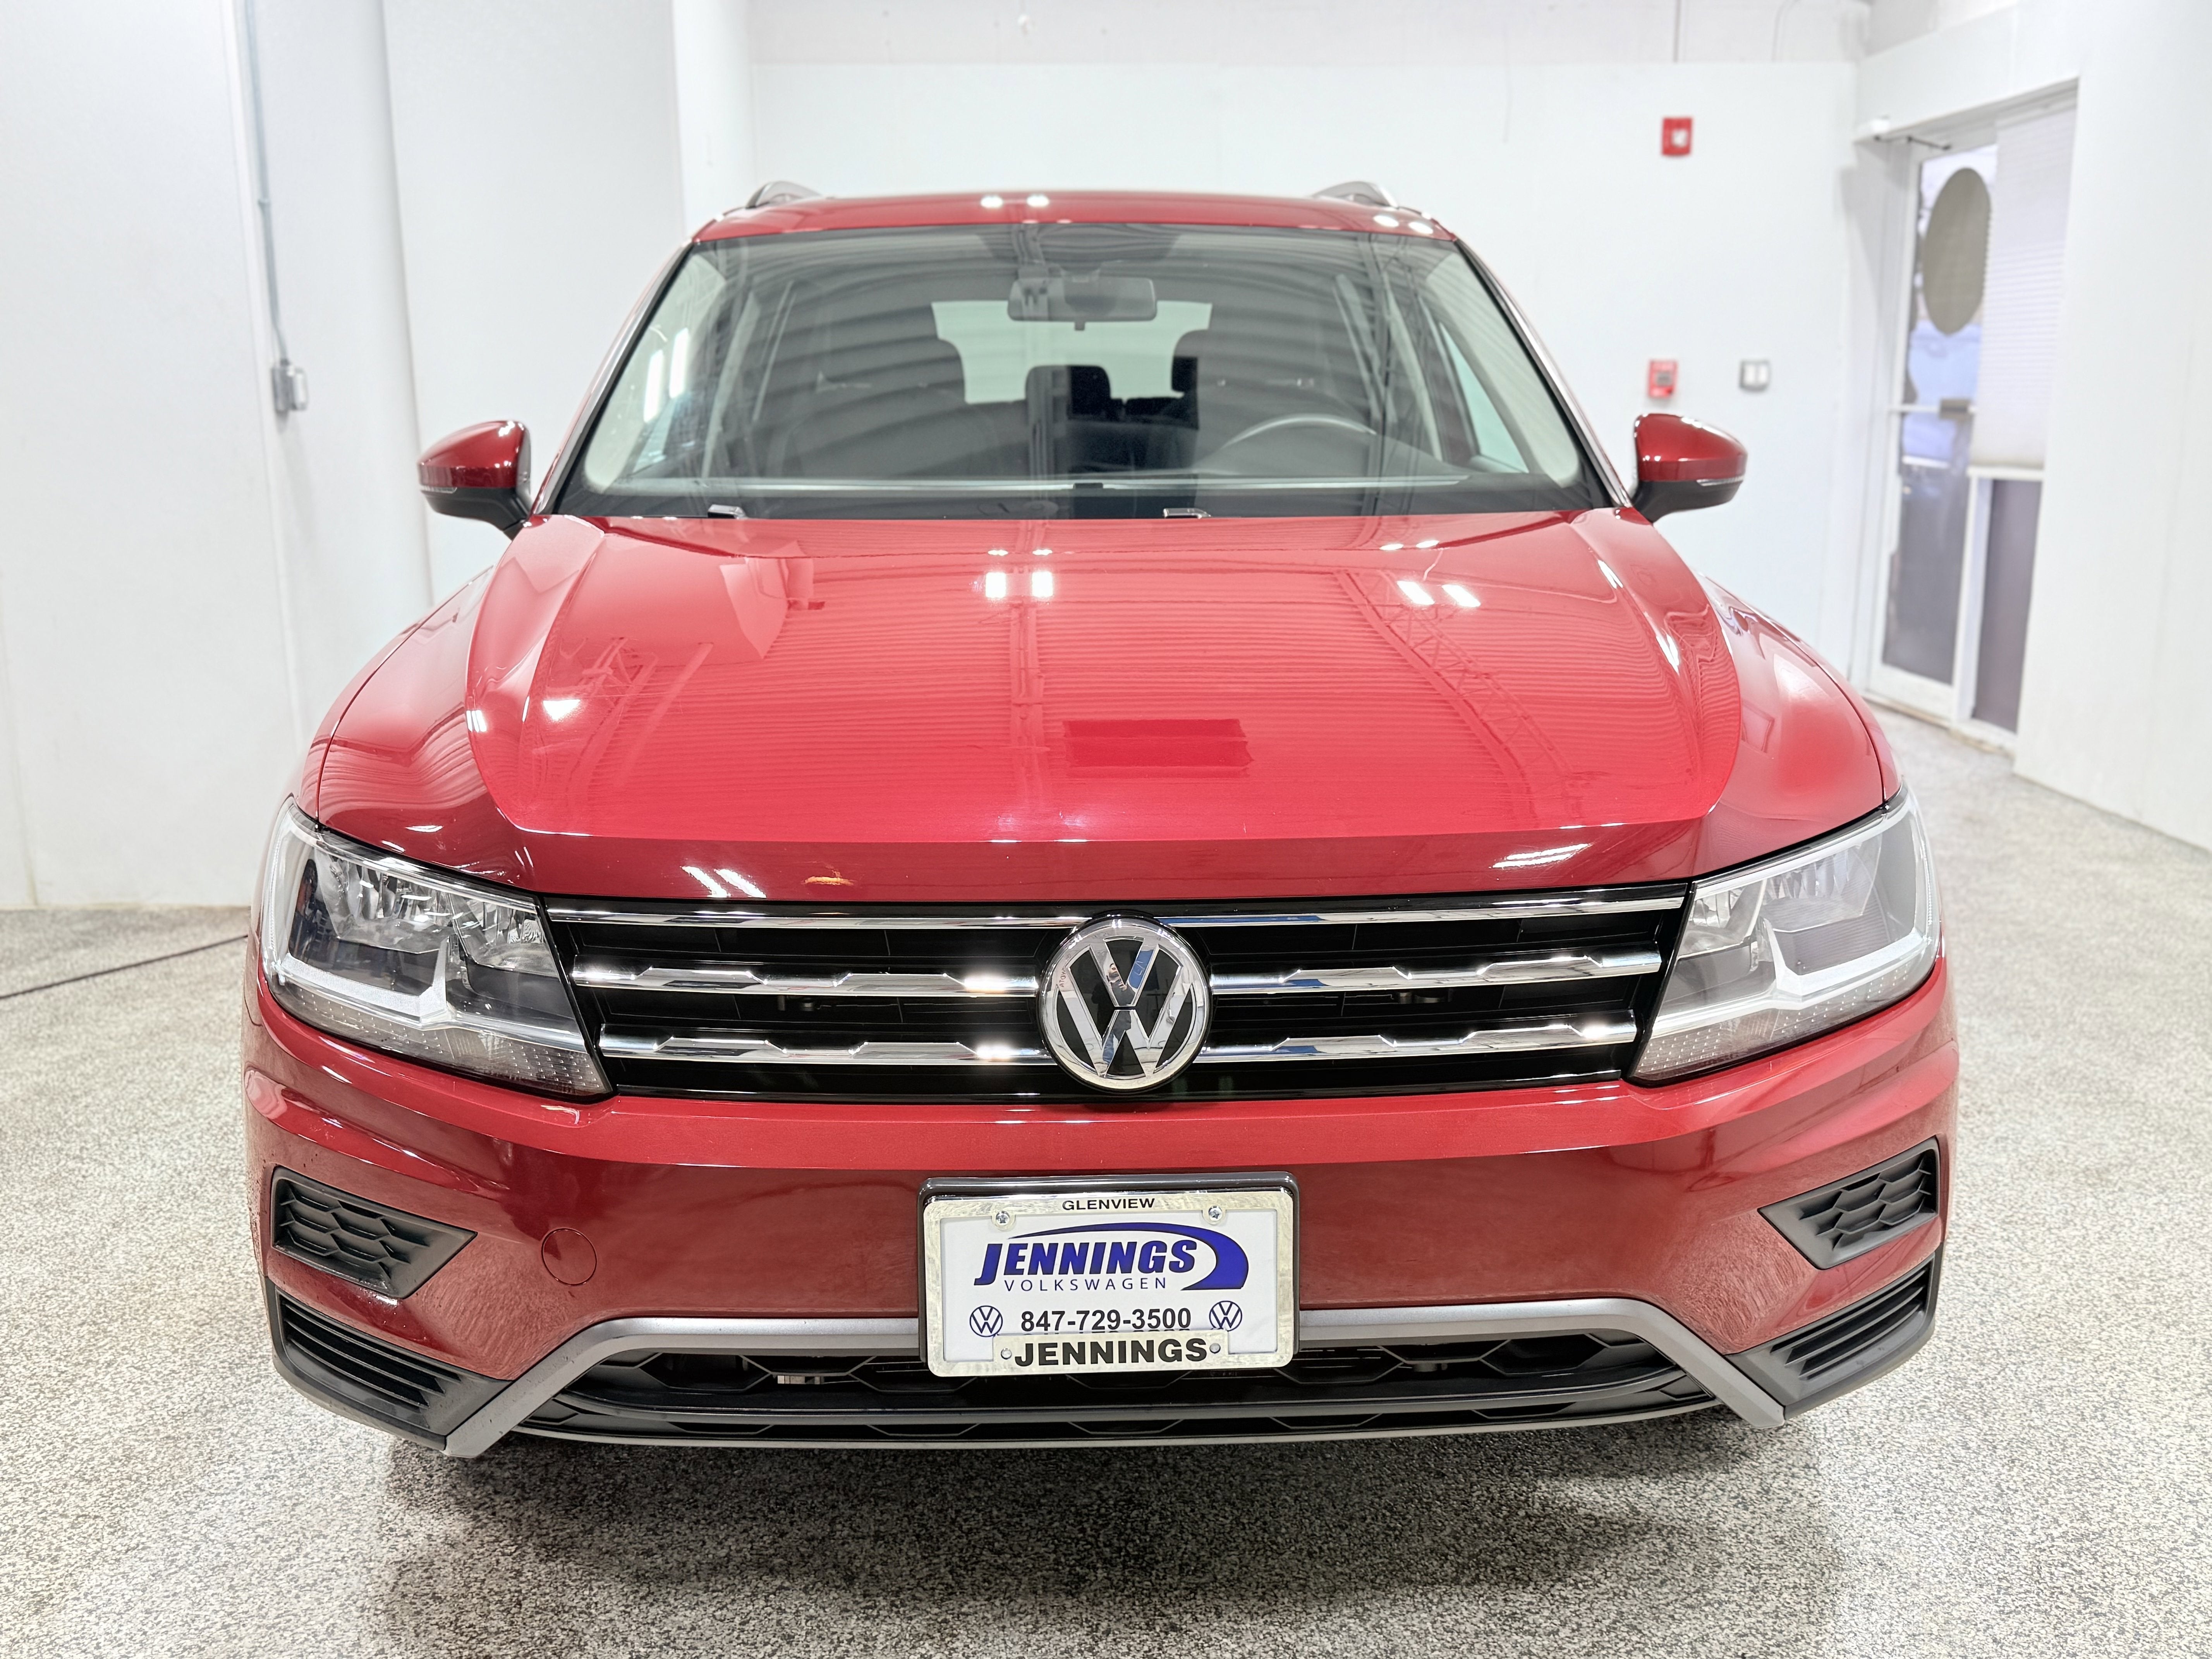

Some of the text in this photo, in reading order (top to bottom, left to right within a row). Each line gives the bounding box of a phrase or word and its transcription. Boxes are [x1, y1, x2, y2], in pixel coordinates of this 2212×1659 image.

[1062, 1198, 1155, 1210] GLENVIEW
[974, 1240, 1197, 1286] JENNINGS
[1005, 1277, 1166, 1291] VOLKSWAGEN
[1021, 1307, 1191, 1332] 847-729-3500
[1014, 1338, 1207, 1367] JENNINGS
